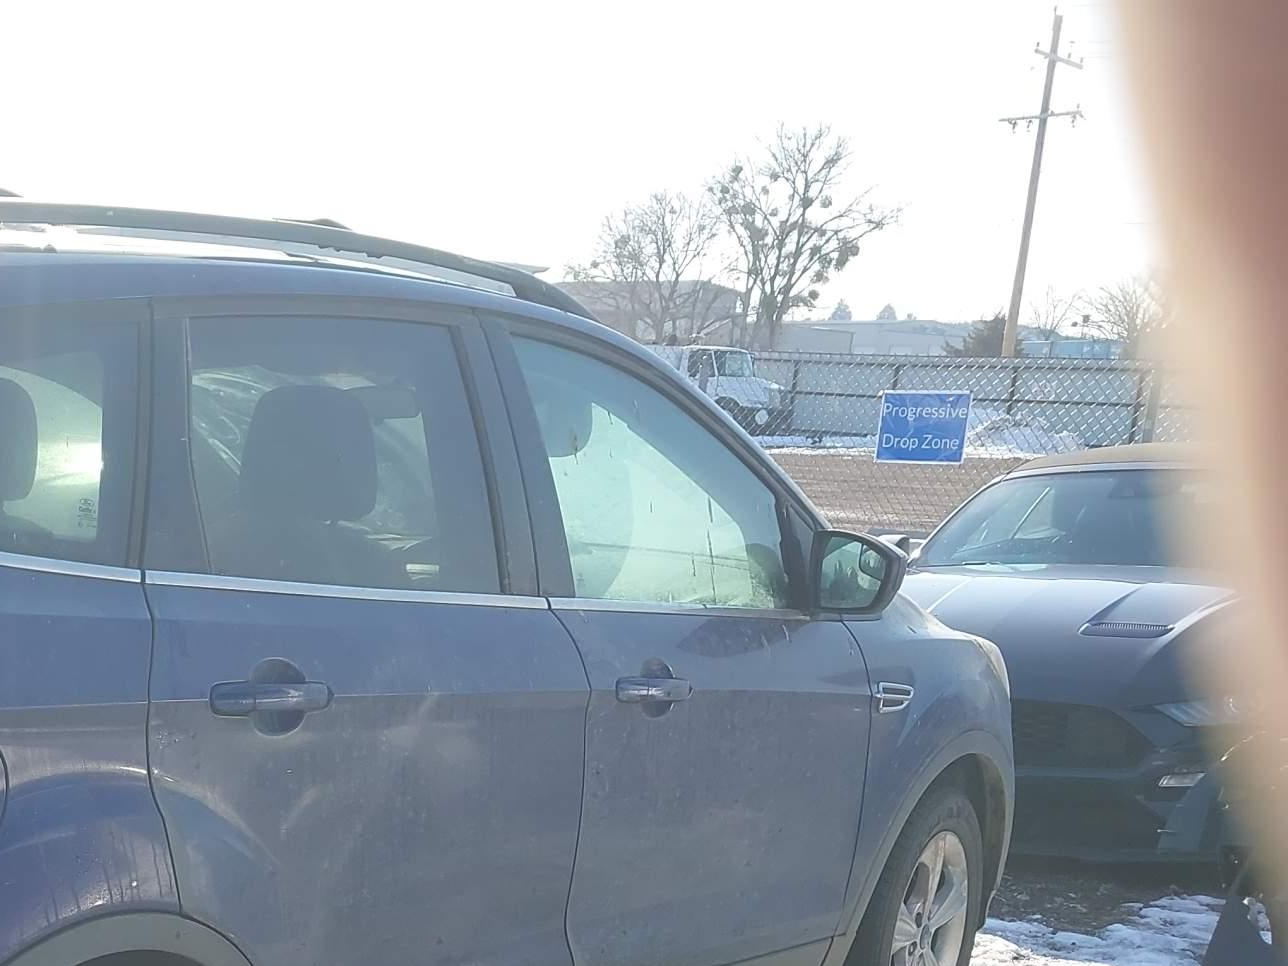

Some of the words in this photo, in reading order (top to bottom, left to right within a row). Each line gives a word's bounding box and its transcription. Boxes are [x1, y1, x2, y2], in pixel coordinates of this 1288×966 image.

[883, 402, 968, 421] Progressive
[882, 433, 919, 451] Drop
[921, 434, 959, 449] Zone
